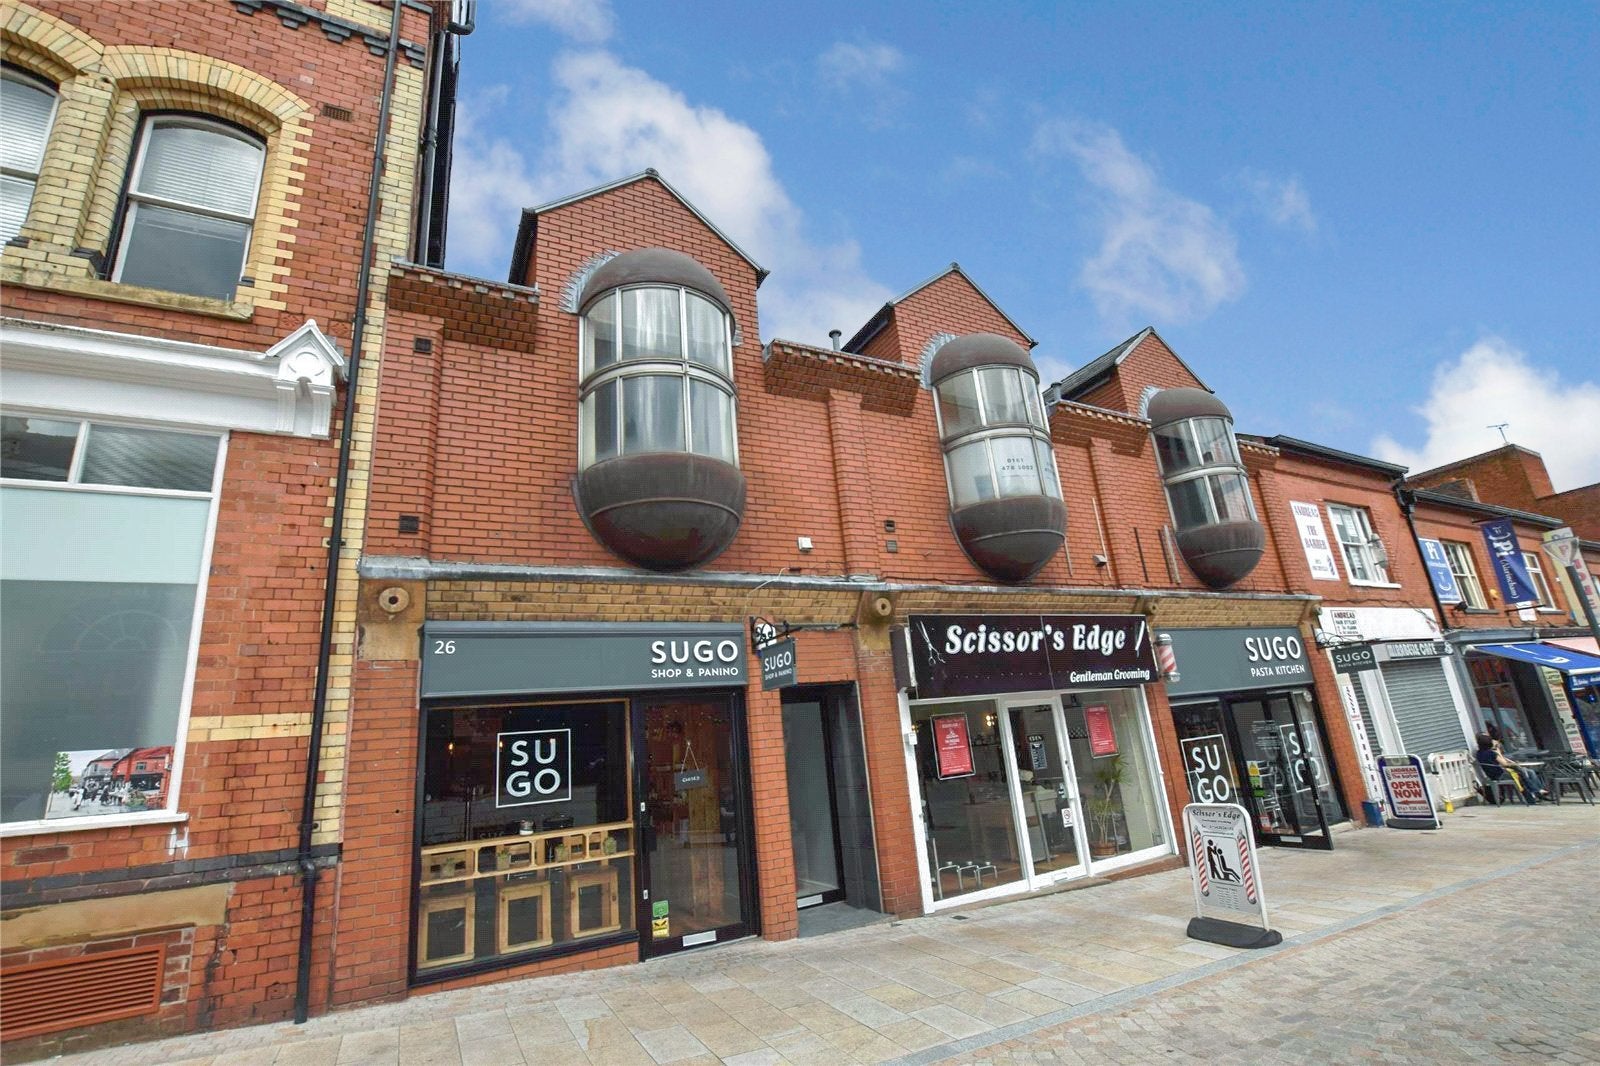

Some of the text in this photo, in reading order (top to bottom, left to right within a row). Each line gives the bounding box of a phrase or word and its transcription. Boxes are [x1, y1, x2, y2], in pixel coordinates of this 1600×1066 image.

[434, 640, 456, 655] 26
[945, 624, 1126, 656] Scissor's Edge
[1245, 636, 1302, 662] SUGO
[650, 640, 739, 664] SUGO
[1335, 650, 1371, 663] SUGO
[764, 651, 792, 672] SUGO
[1251, 664, 1305, 677] PASTA KITCHEN
[651, 666, 739, 679] SHOP & PANINO
[1069, 668, 1150, 683] Gentleman Grooming
[511, 738, 557, 766] SU
[1192, 744, 1221, 773] SU
[506, 768, 560, 798] GO
[1197, 774, 1230, 803] GO
[1391, 780, 1421, 789] OPEN
[1394, 789, 1423, 799] NOW
[1223, 811, 1241, 821] Edge
